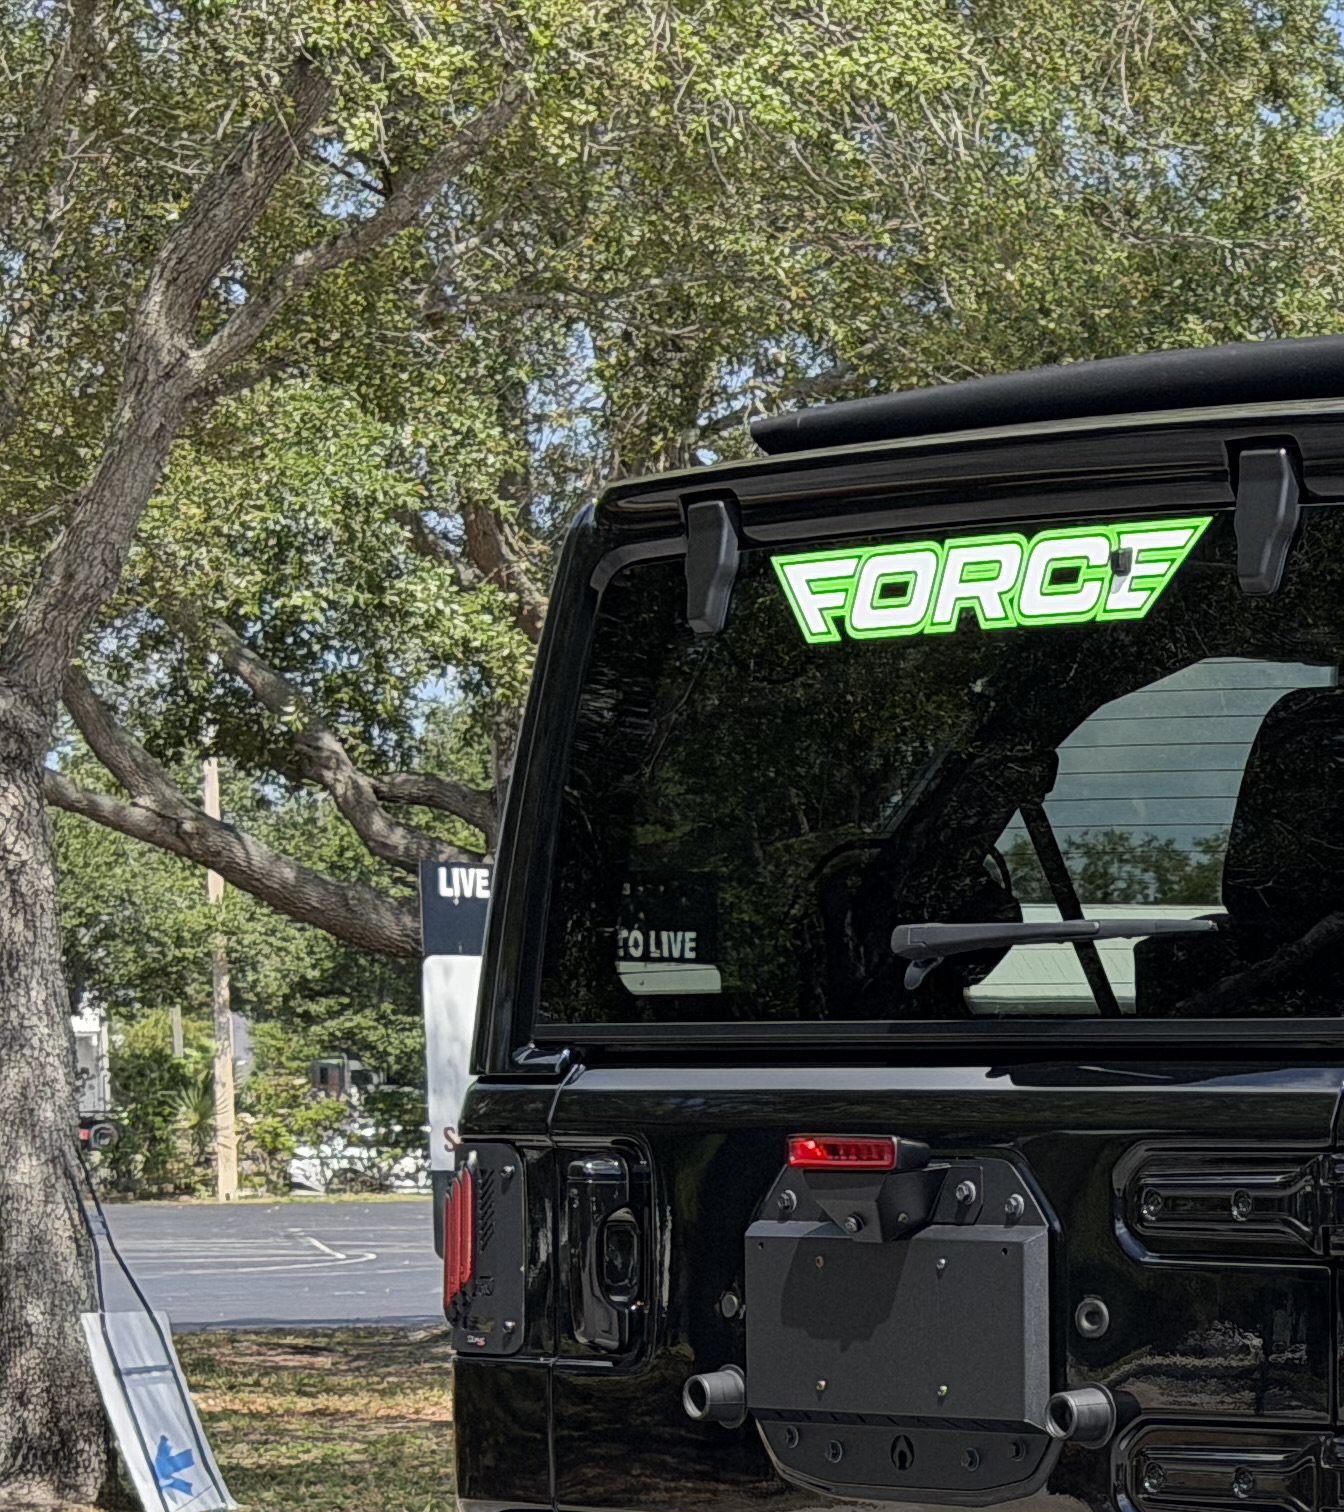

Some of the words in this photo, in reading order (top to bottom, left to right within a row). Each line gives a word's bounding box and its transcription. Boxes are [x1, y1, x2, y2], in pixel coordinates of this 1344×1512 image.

[771, 516, 1213, 643] FORCE
[437, 866, 491, 899] LIVE
[649, 930, 697, 959] LIVE
